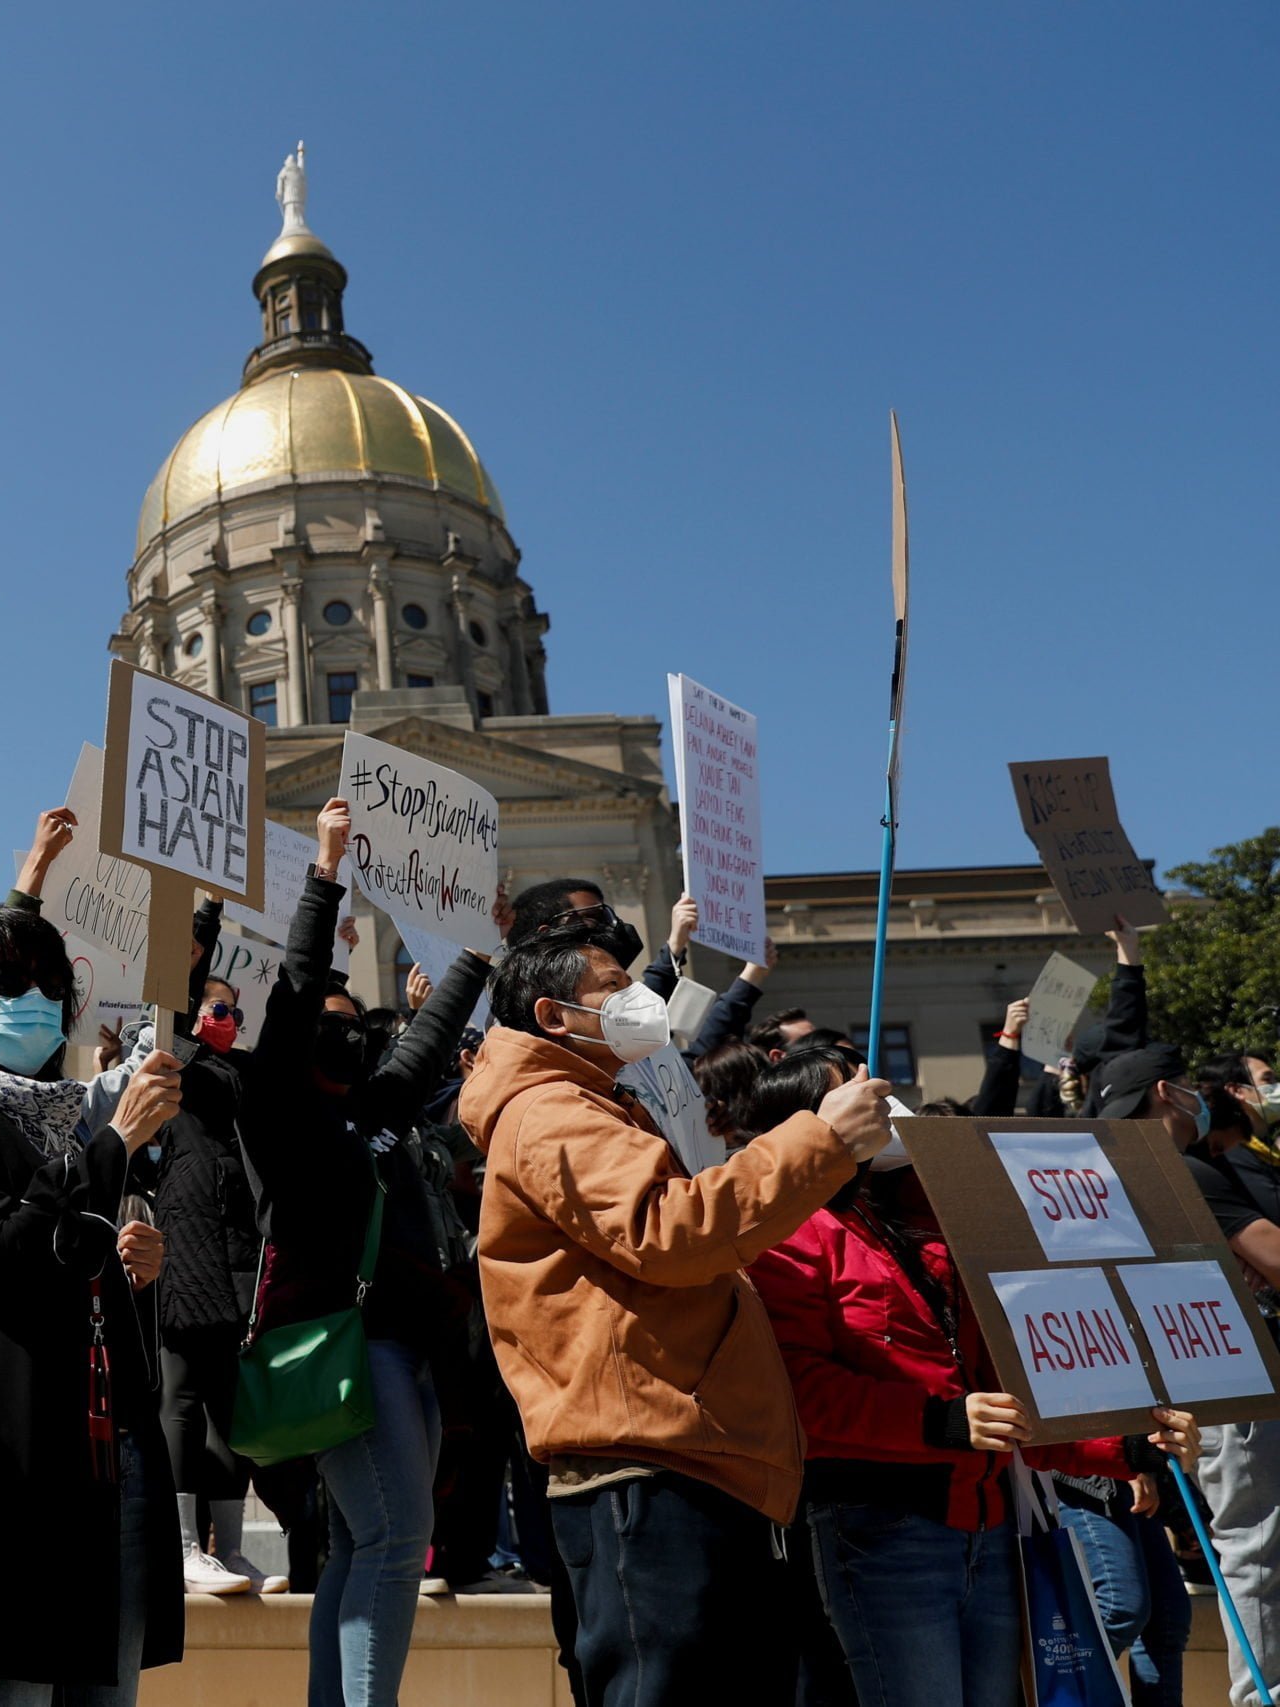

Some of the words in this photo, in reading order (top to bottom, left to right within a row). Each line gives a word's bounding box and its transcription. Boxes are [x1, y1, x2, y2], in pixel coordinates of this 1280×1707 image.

[145, 697, 248, 778] STOP
[136, 748, 244, 825] ASIAN
[350, 759, 497, 852] #StopAsianHate
[1022, 773, 1070, 826] RISE
[137, 792, 246, 883] HATE
[345, 833, 487, 921] ProtectAsianWomen
[1027, 1169, 1109, 1221] STOP
[1024, 1308, 1131, 1373] ASIAN
[1153, 1300, 1242, 1360] HATE
